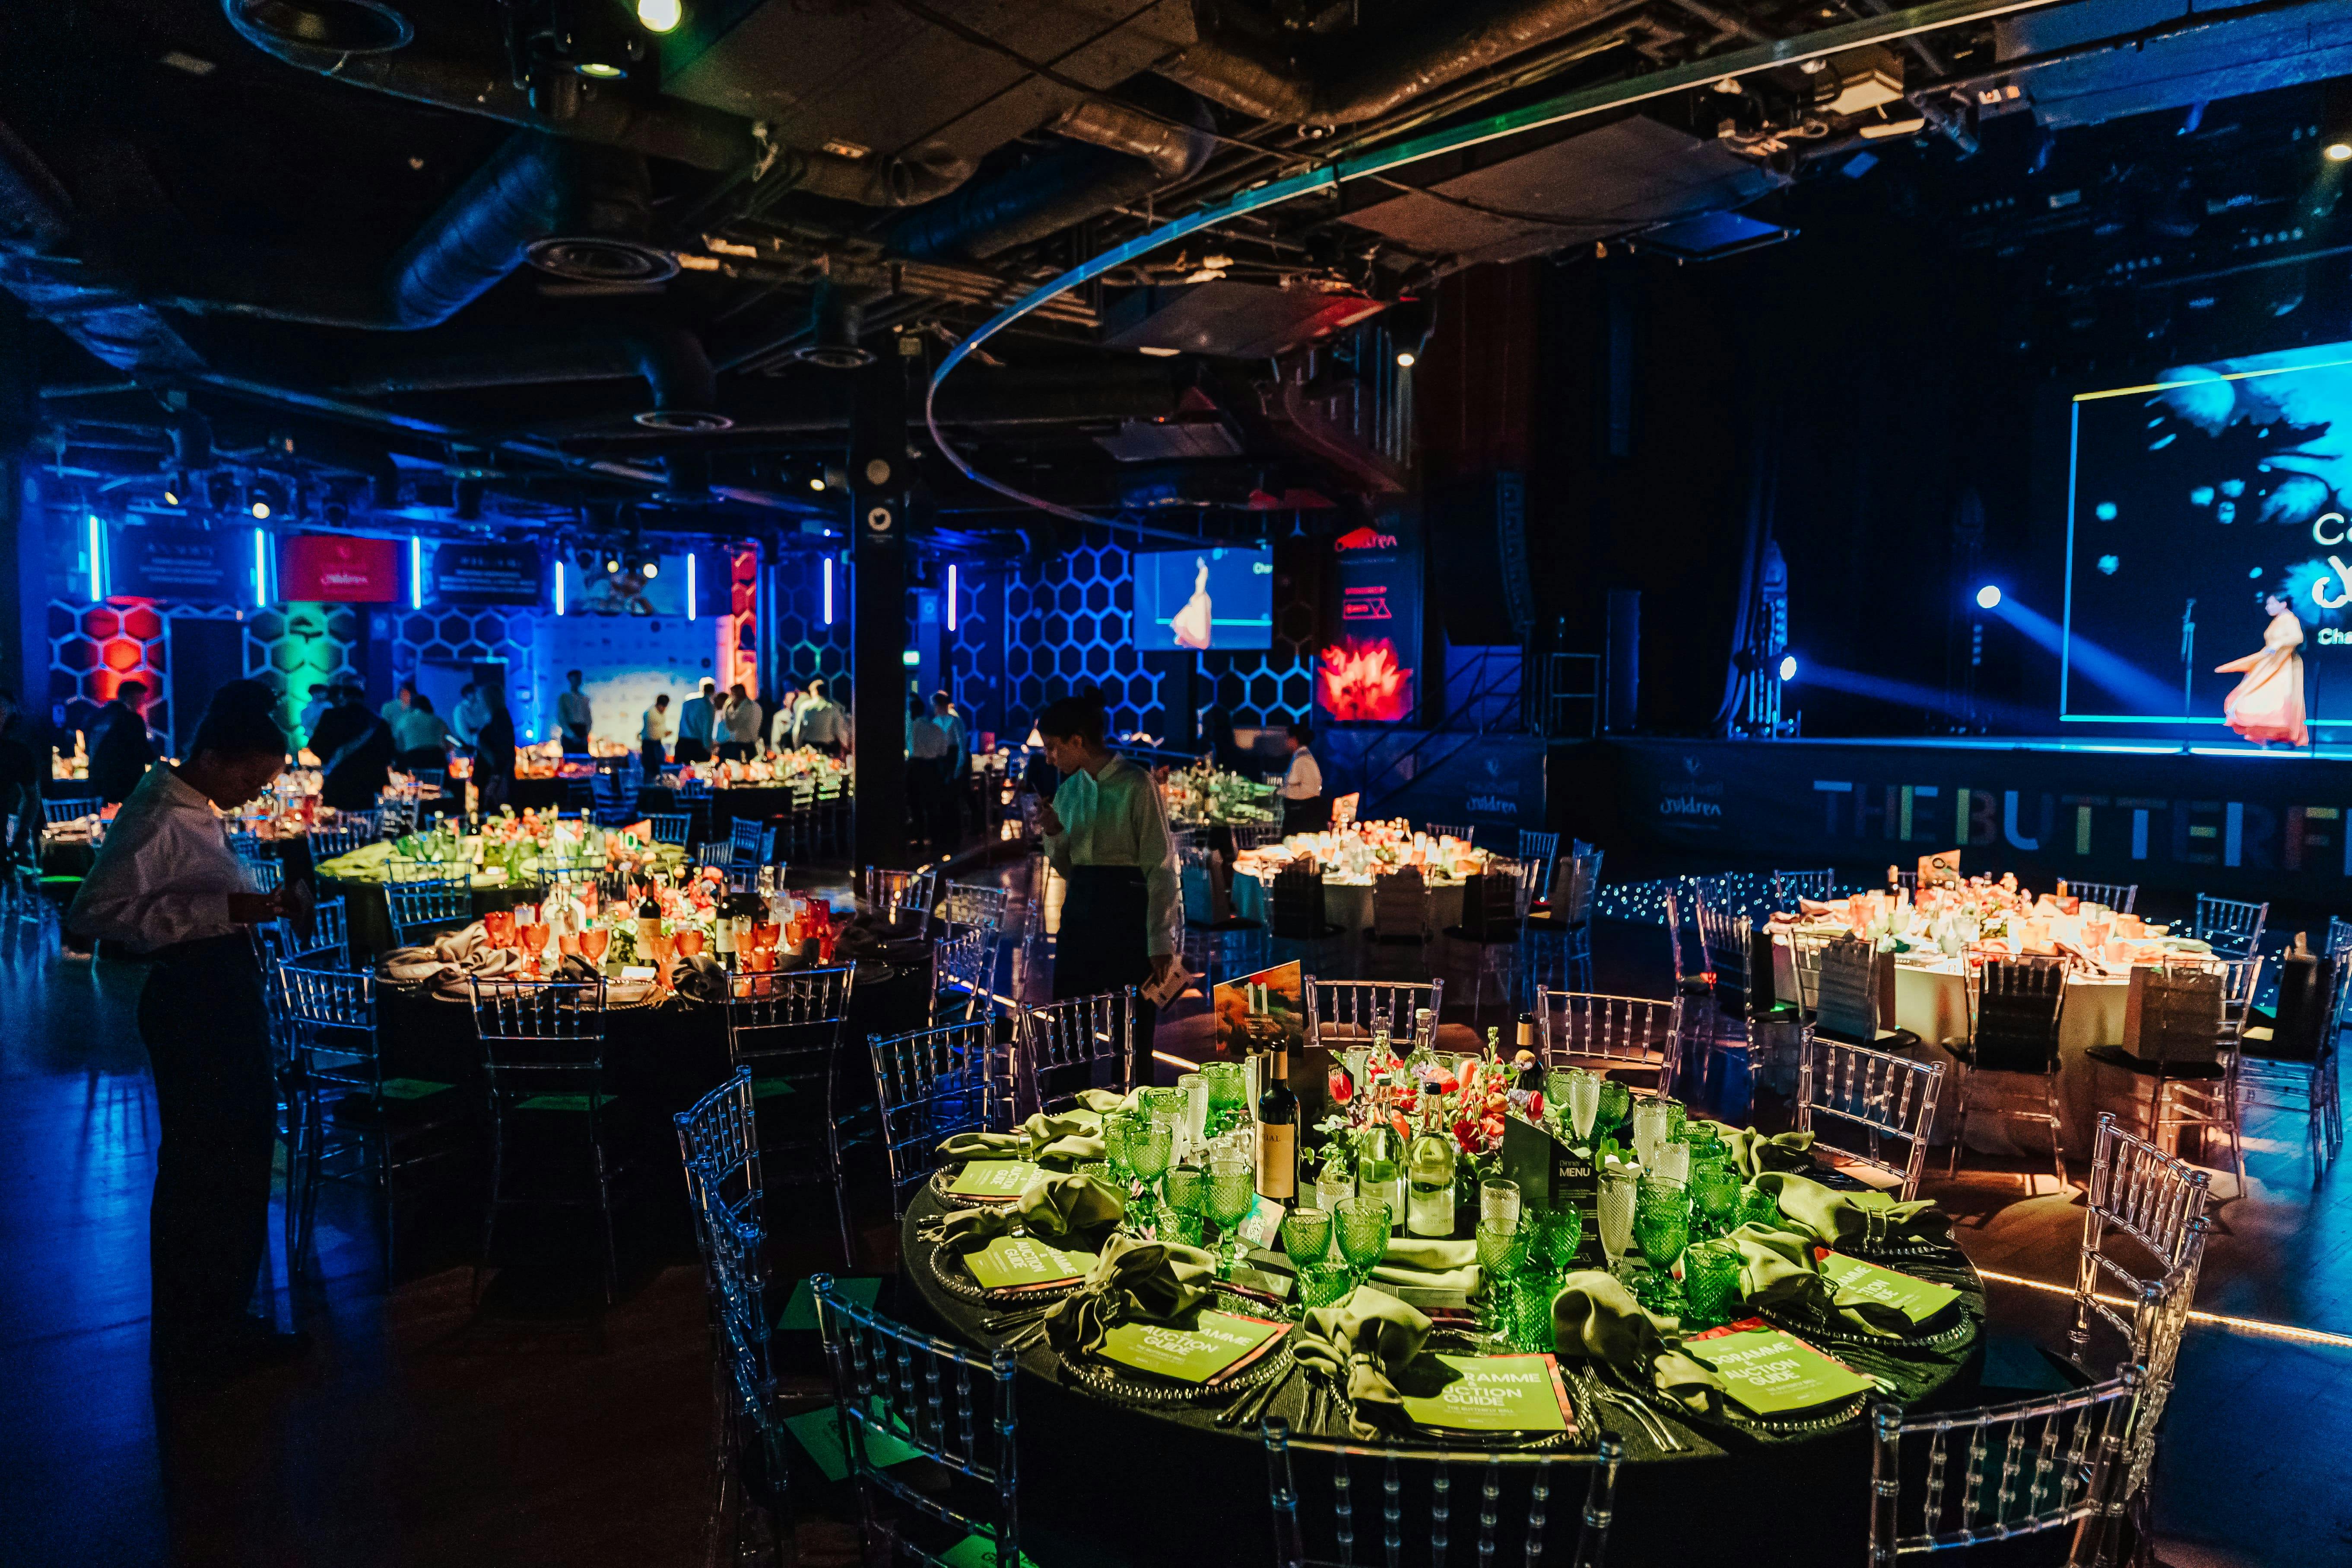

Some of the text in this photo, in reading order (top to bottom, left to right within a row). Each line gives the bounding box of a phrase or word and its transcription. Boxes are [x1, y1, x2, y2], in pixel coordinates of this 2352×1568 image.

[1813, 780, 1939, 842] THE
[617, 830, 638, 851] 10
[1244, 982, 1268, 1015] 11
[1560, 1168, 1590, 1177] MENU
[1004, 1248, 1028, 1269] GUIDE
[1014, 1241, 1047, 1273] AUCTION
[1140, 1325, 1219, 1353] AUCTION
[1143, 1336, 1195, 1356] GUIDE
[1724, 1358, 1801, 1380] AUCTION
[1748, 1370, 1800, 1386] GUIDE
[1443, 1394, 1505, 1406] GUIDE
